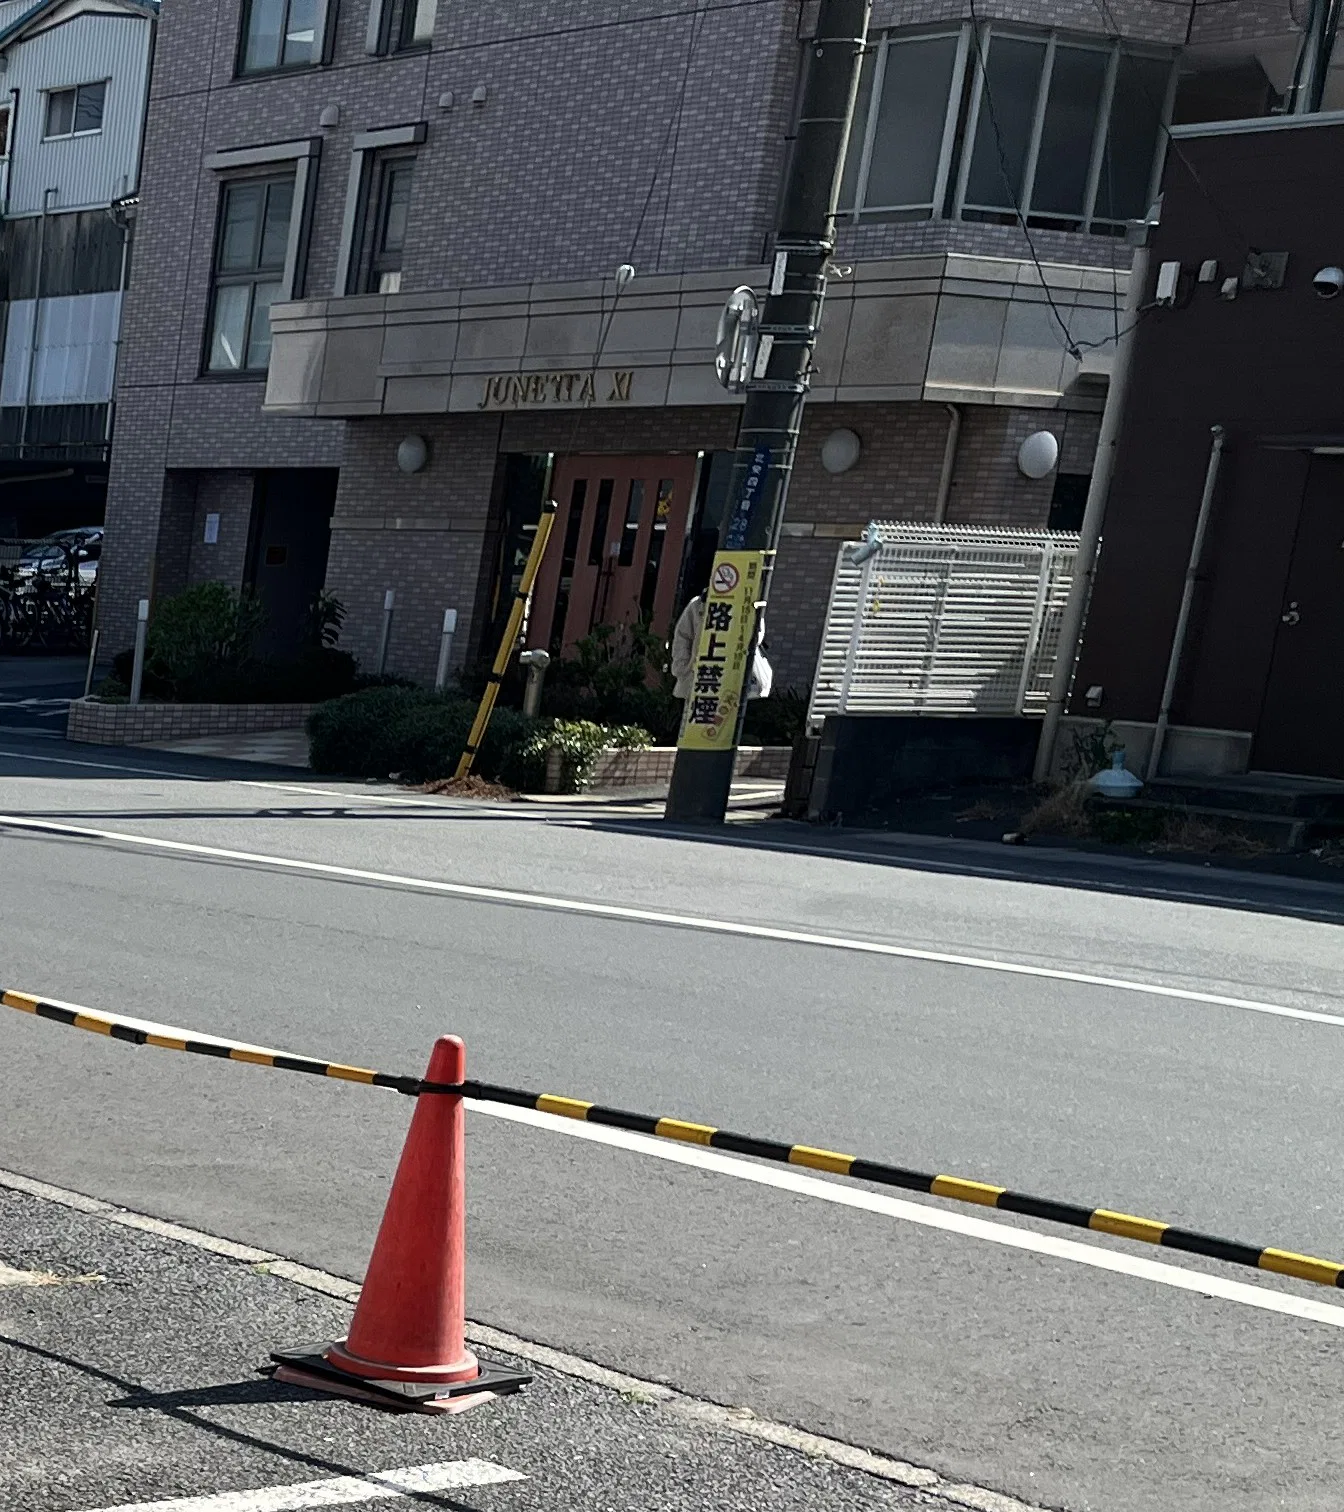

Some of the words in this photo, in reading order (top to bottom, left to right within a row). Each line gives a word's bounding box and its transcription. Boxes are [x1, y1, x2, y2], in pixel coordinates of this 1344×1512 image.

[607, 371, 634, 402] XI
[689, 602, 733, 724] 路上禁煙
